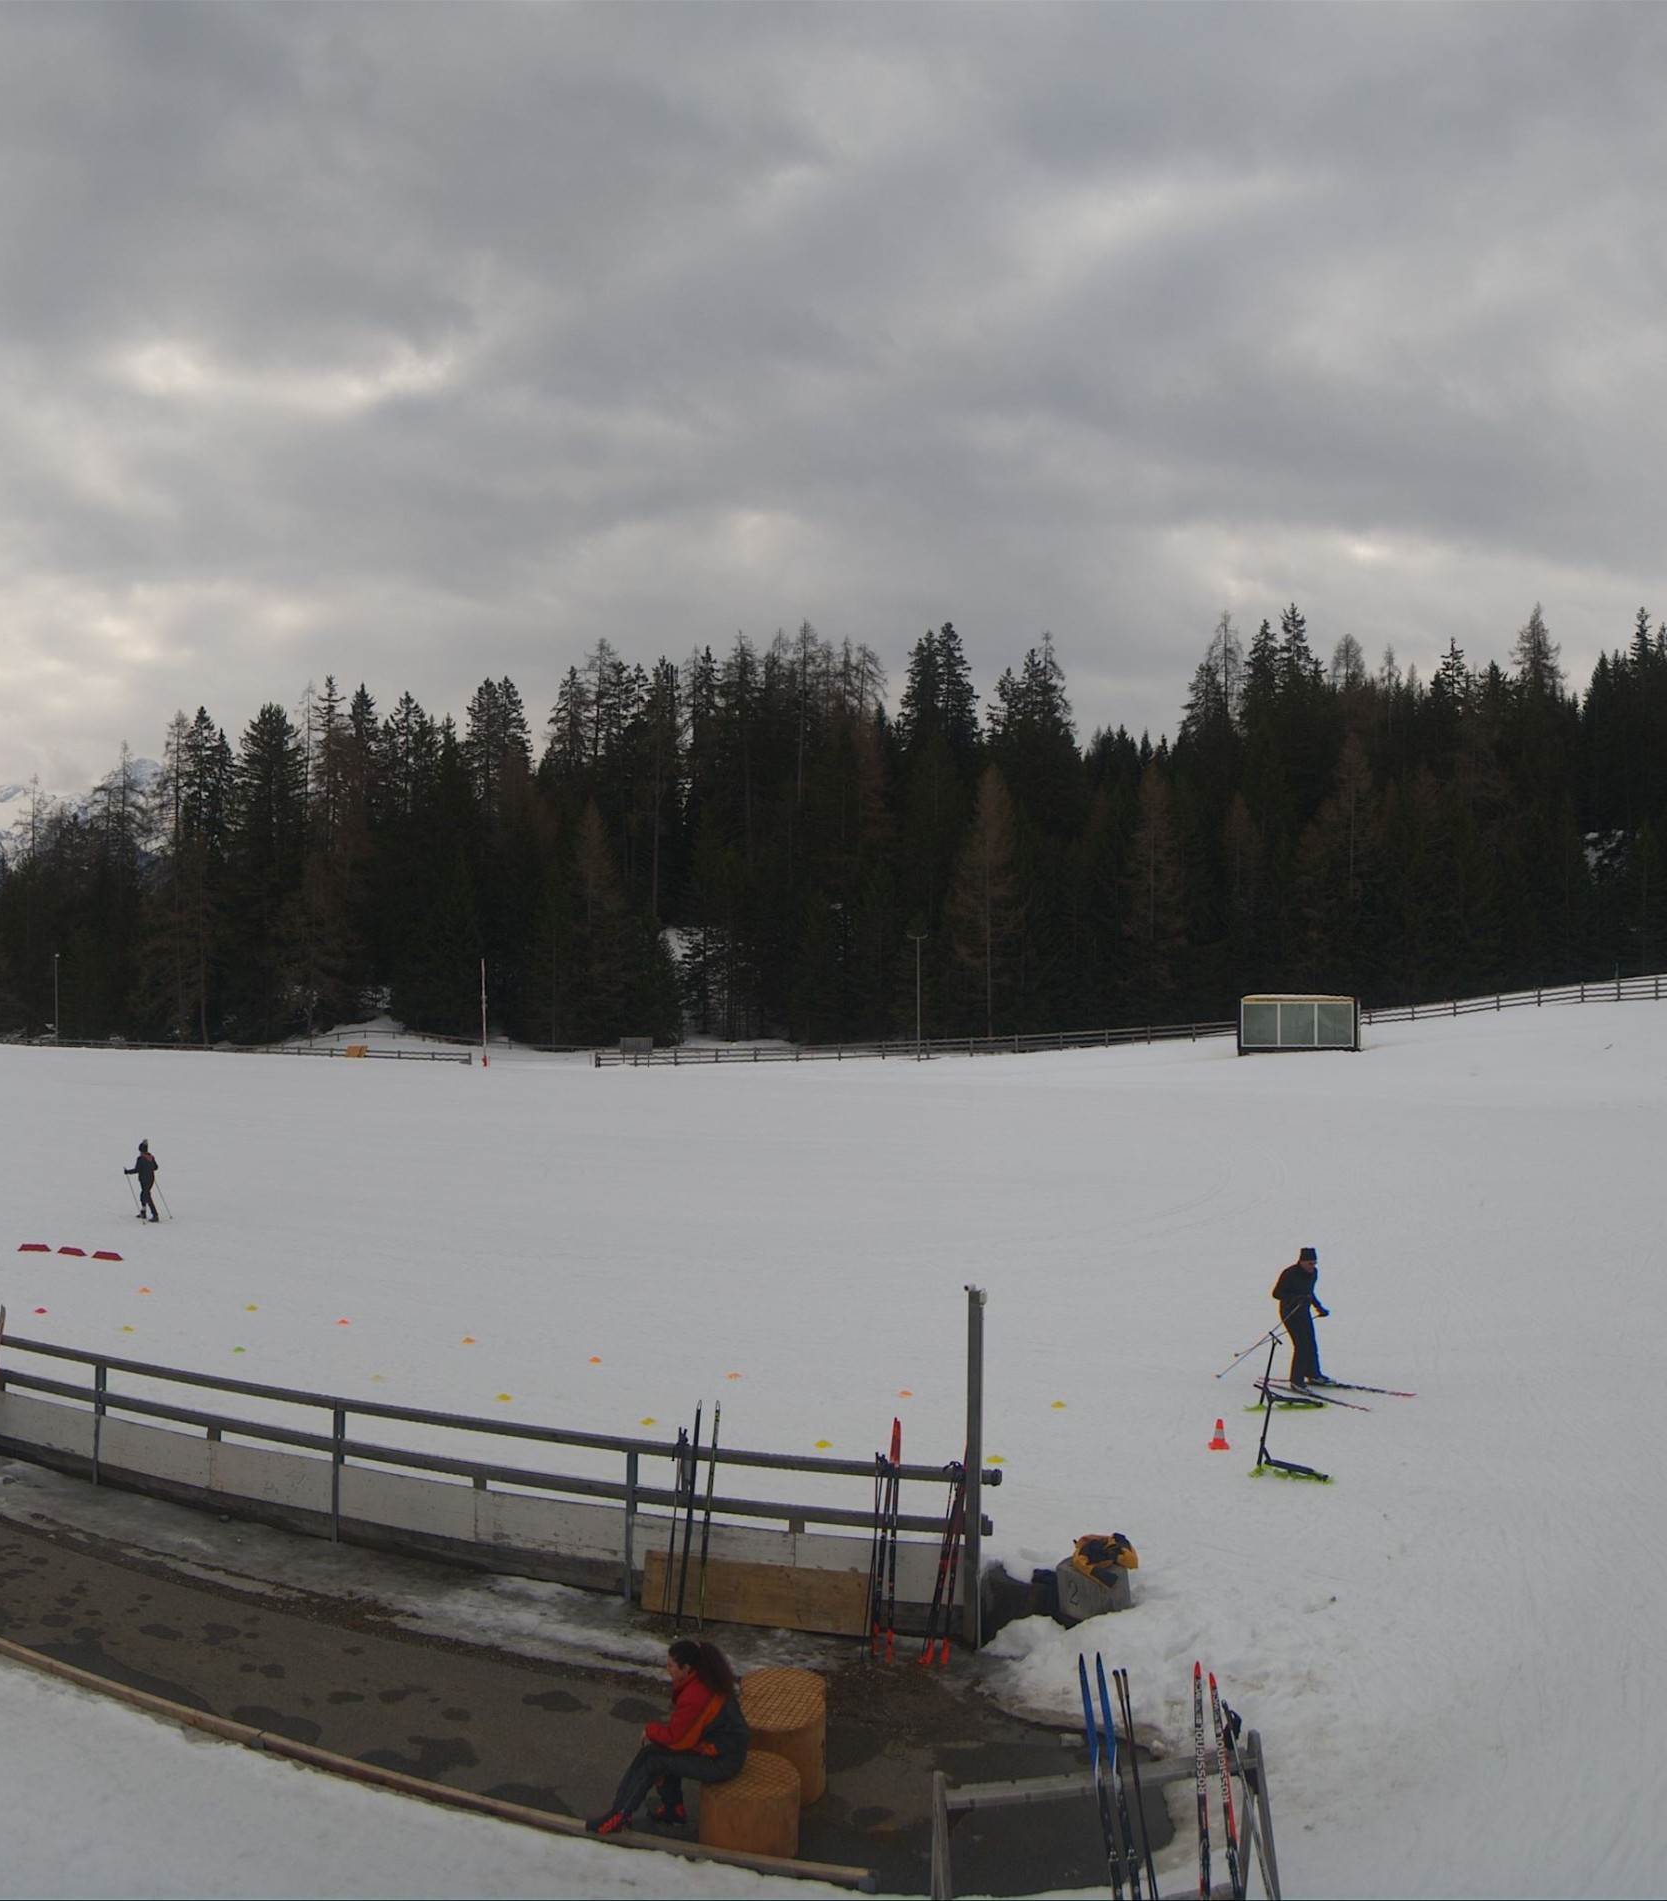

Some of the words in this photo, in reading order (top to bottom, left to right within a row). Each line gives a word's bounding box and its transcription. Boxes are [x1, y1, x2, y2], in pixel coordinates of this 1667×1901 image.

[1068, 1580, 1080, 1607] 2
[1195, 1723, 1208, 1795] ROSSIGNOL
[1216, 1732, 1231, 1804] ROSSIGNOL
